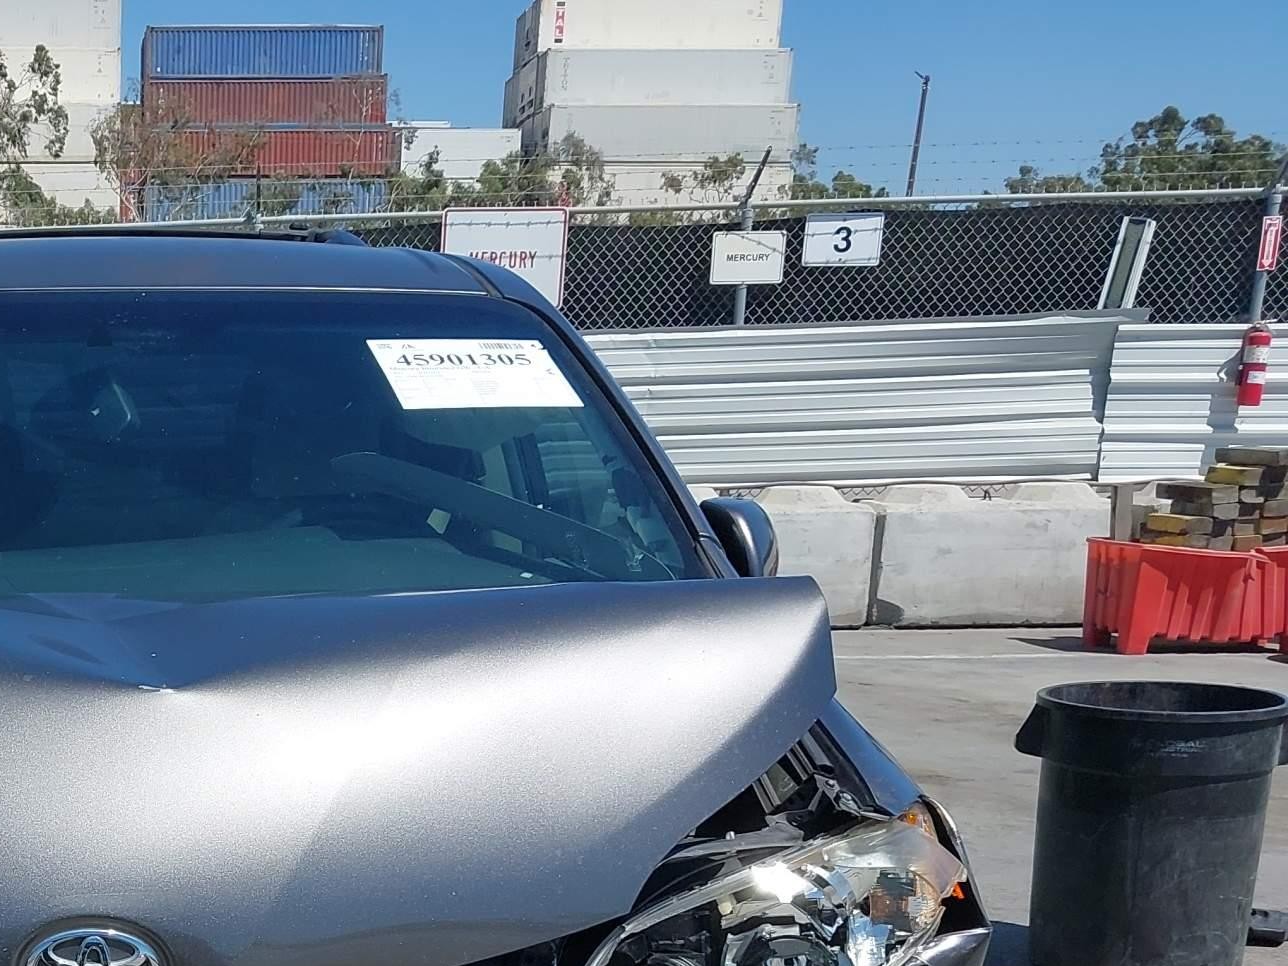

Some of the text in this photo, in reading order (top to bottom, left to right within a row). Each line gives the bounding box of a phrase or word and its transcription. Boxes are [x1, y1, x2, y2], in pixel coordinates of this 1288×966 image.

[833, 226, 852, 253] 3
[726, 253, 770, 262] MERCURY
[396, 353, 532, 366] 45901305
